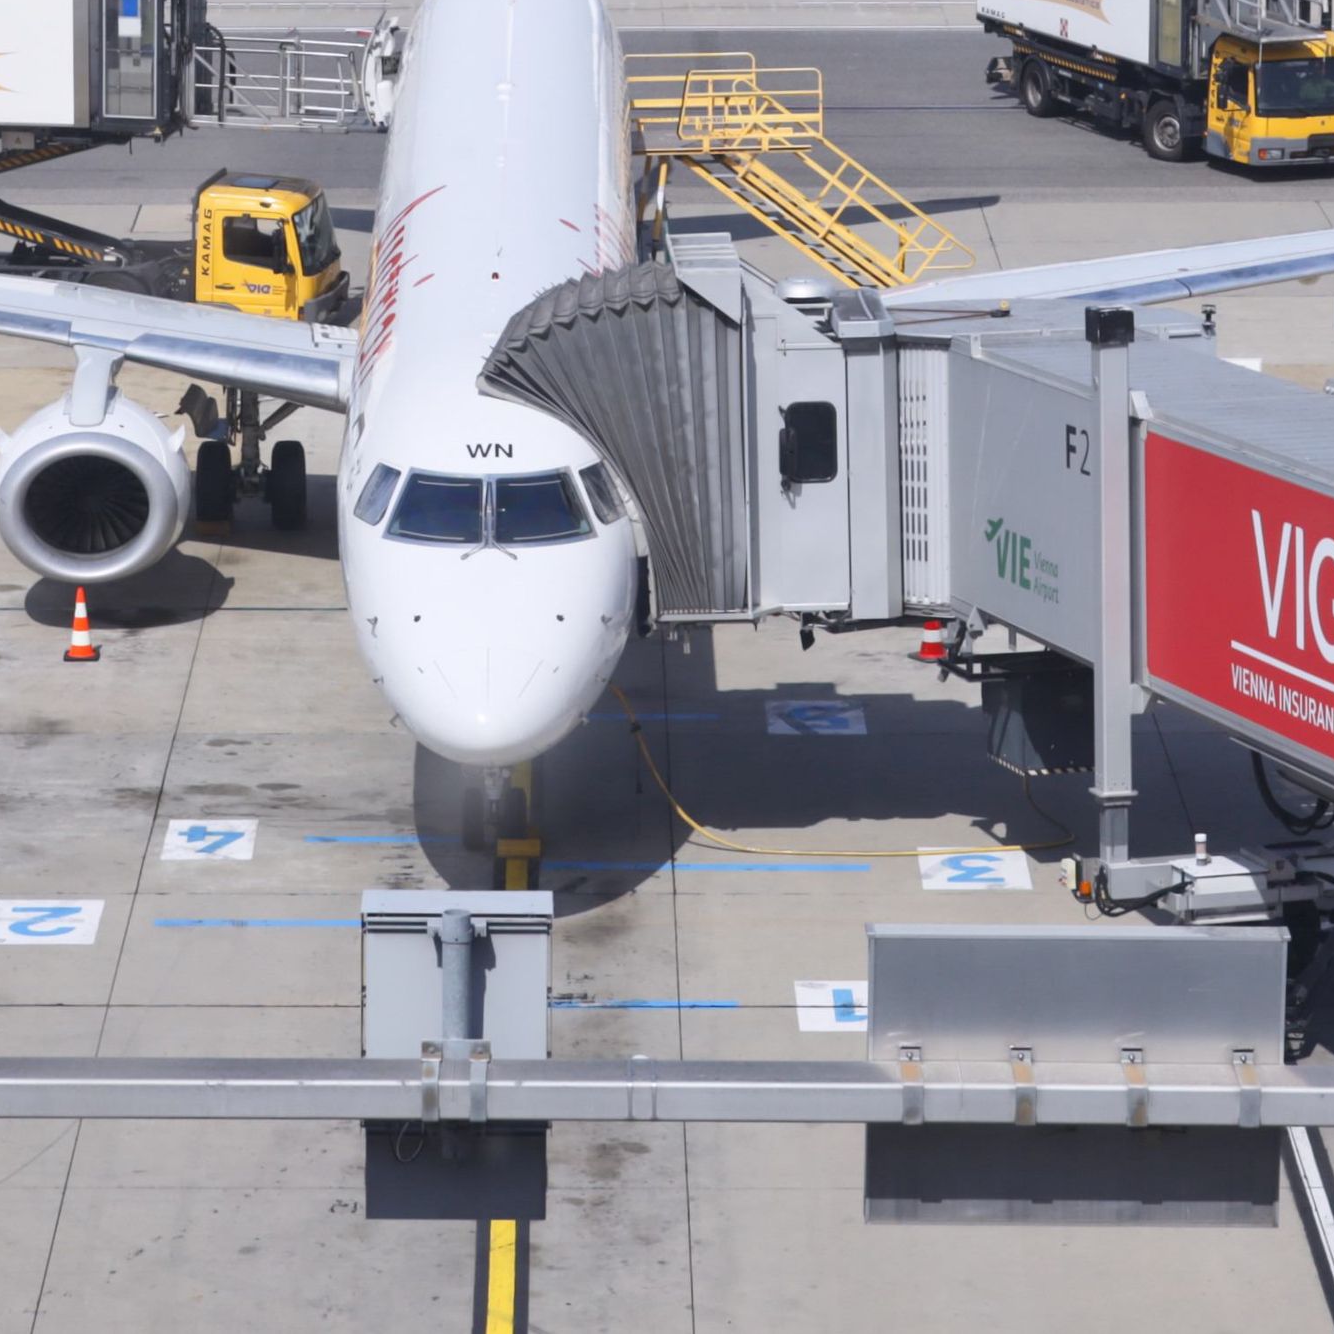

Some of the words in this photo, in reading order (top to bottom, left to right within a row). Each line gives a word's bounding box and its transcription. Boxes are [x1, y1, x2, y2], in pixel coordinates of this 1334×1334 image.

[201, 208, 213, 276] KAMAG
[466, 443, 513, 458] WN
[996, 529, 1032, 590] VIE
[1033, 550, 1059, 578] Vienna
[1033, 577, 1060, 604] Airport
[1230, 662, 1276, 708] VIENNA
[8, 906, 83, 937] 2
